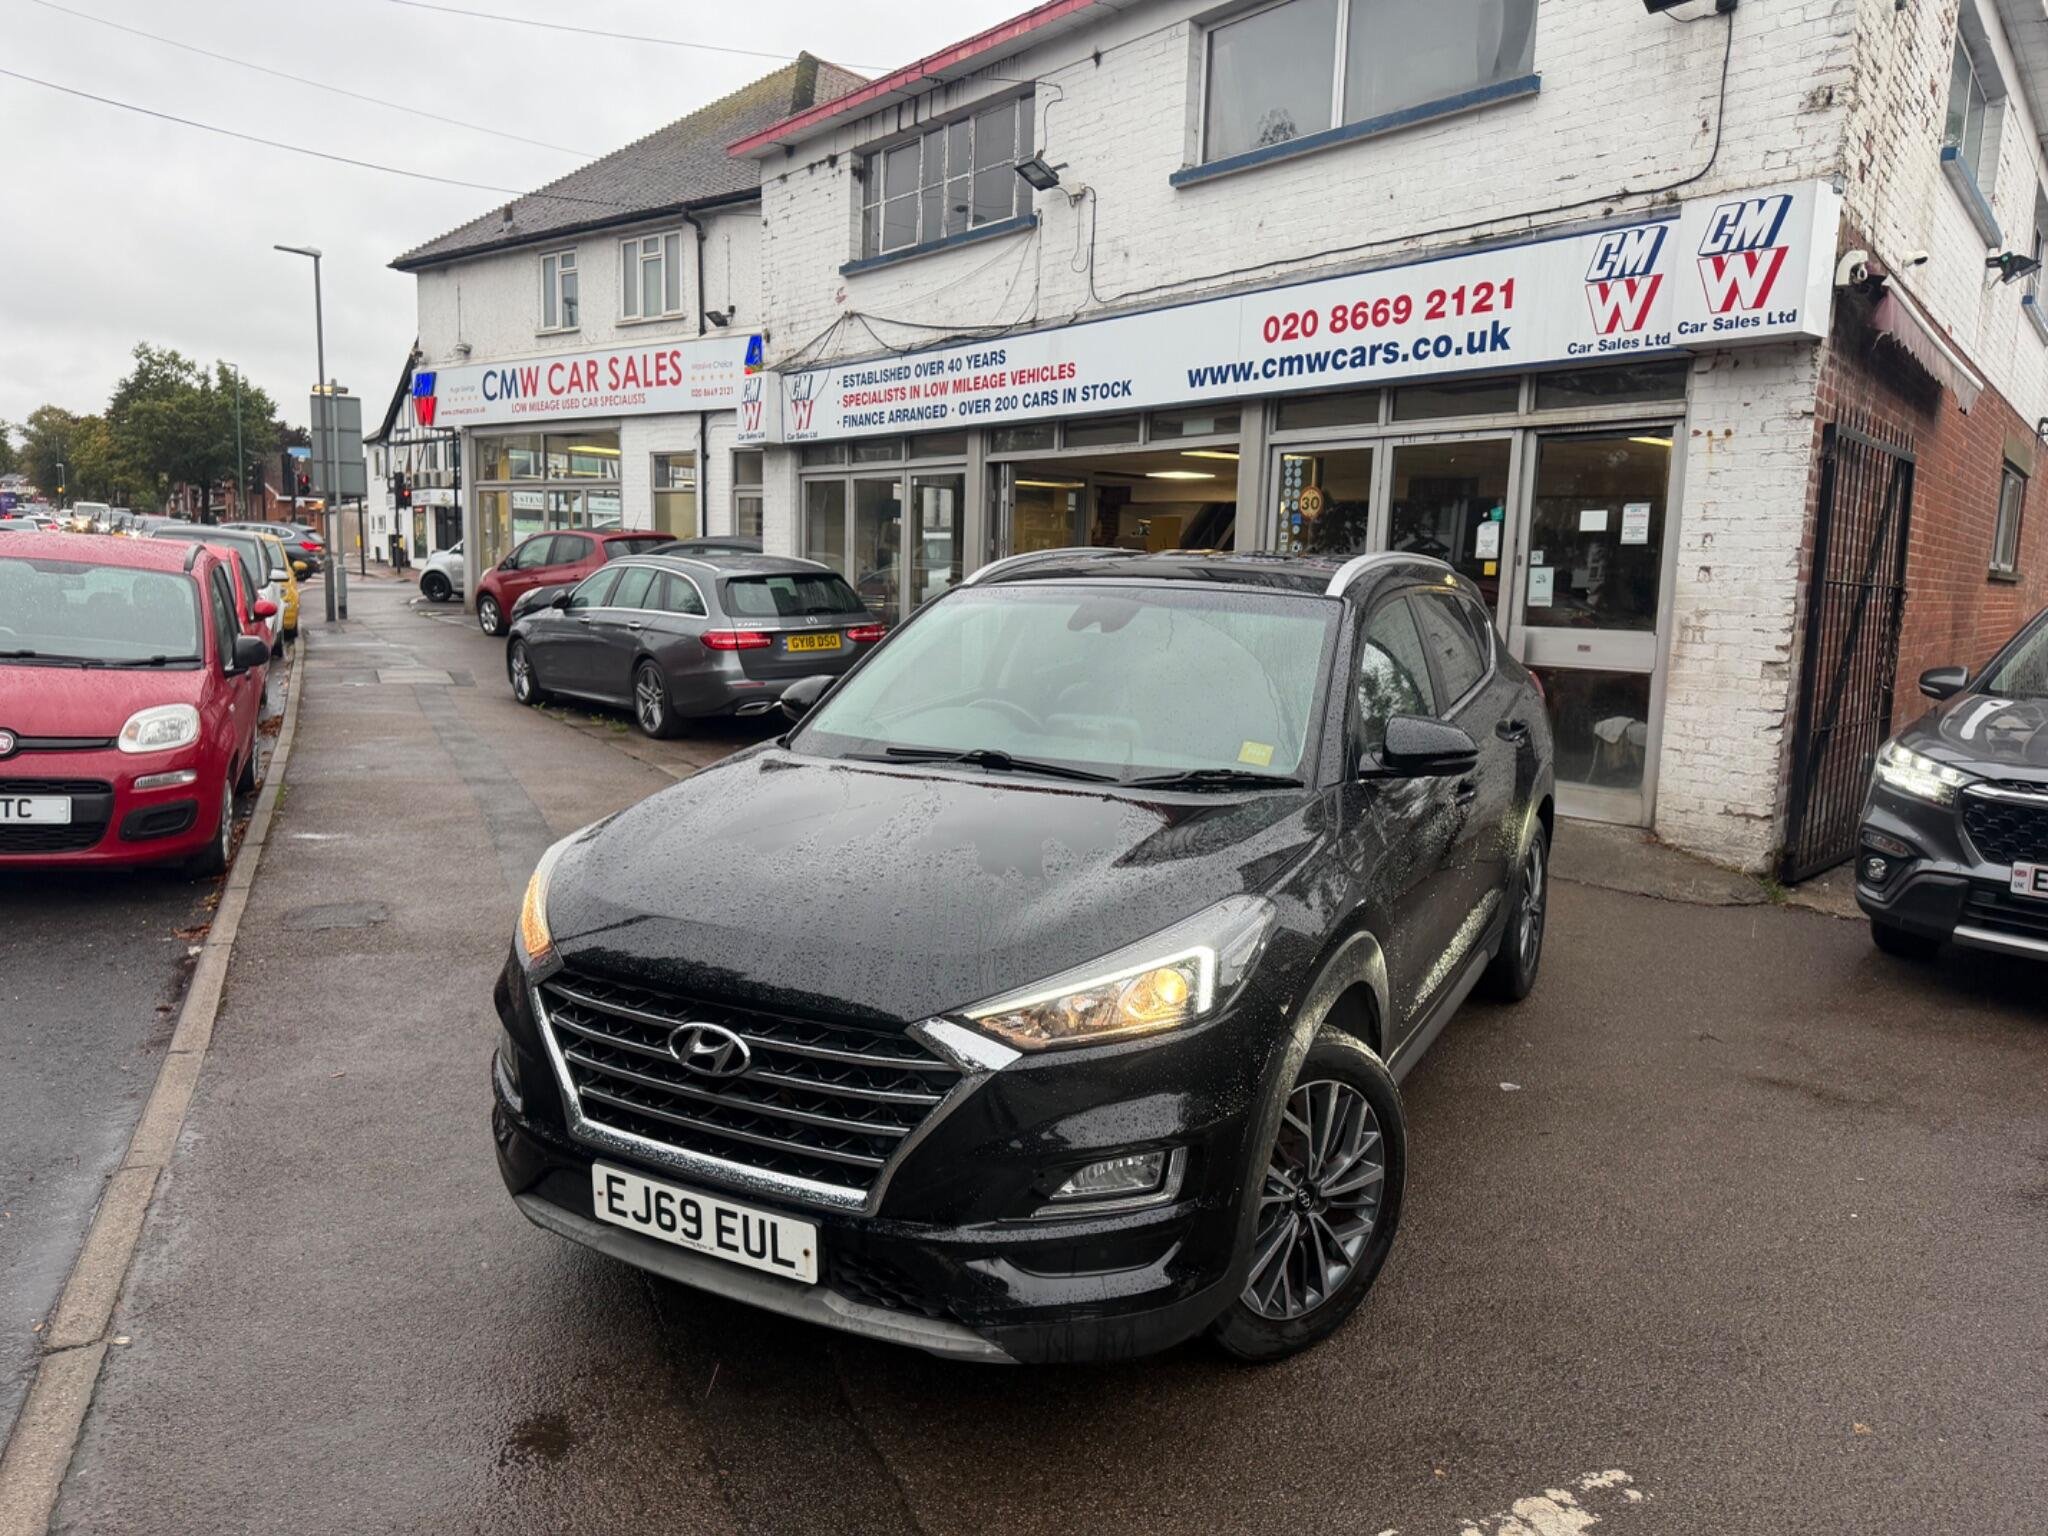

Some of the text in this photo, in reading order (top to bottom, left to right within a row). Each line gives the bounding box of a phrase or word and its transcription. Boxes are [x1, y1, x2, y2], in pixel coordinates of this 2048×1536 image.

[1698, 194, 1793, 257] CM
[1585, 225, 1668, 282] CM
[1585, 274, 1664, 335] W
[1697, 245, 1789, 314] W
[1263, 278, 1514, 343] 020 8669 2121
[1678, 309, 1797, 334] Car Sales Ltd
[843, 349, 1006, 388] ESTABLISHED OVER 40 YEARS
[1187, 320, 1511, 388] www.cmwcars.co.uk
[1568, 333, 1671, 354] Car Sales Ltd
[482, 350, 682, 401] CMW CAR SALES
[843, 362, 1076, 408] SPECIALISTS IN LOW MILEAGE VEHICLES
[511, 393, 646, 414] LOW MILEAGE USED CAR SPECIALISTS
[843, 380, 1132, 428] FINANCE ARRANGED OVER 200 CARS IN STOCK
[1302, 496, 1319, 510] 30
[606, 1173, 796, 1269] EJ69 EUL
